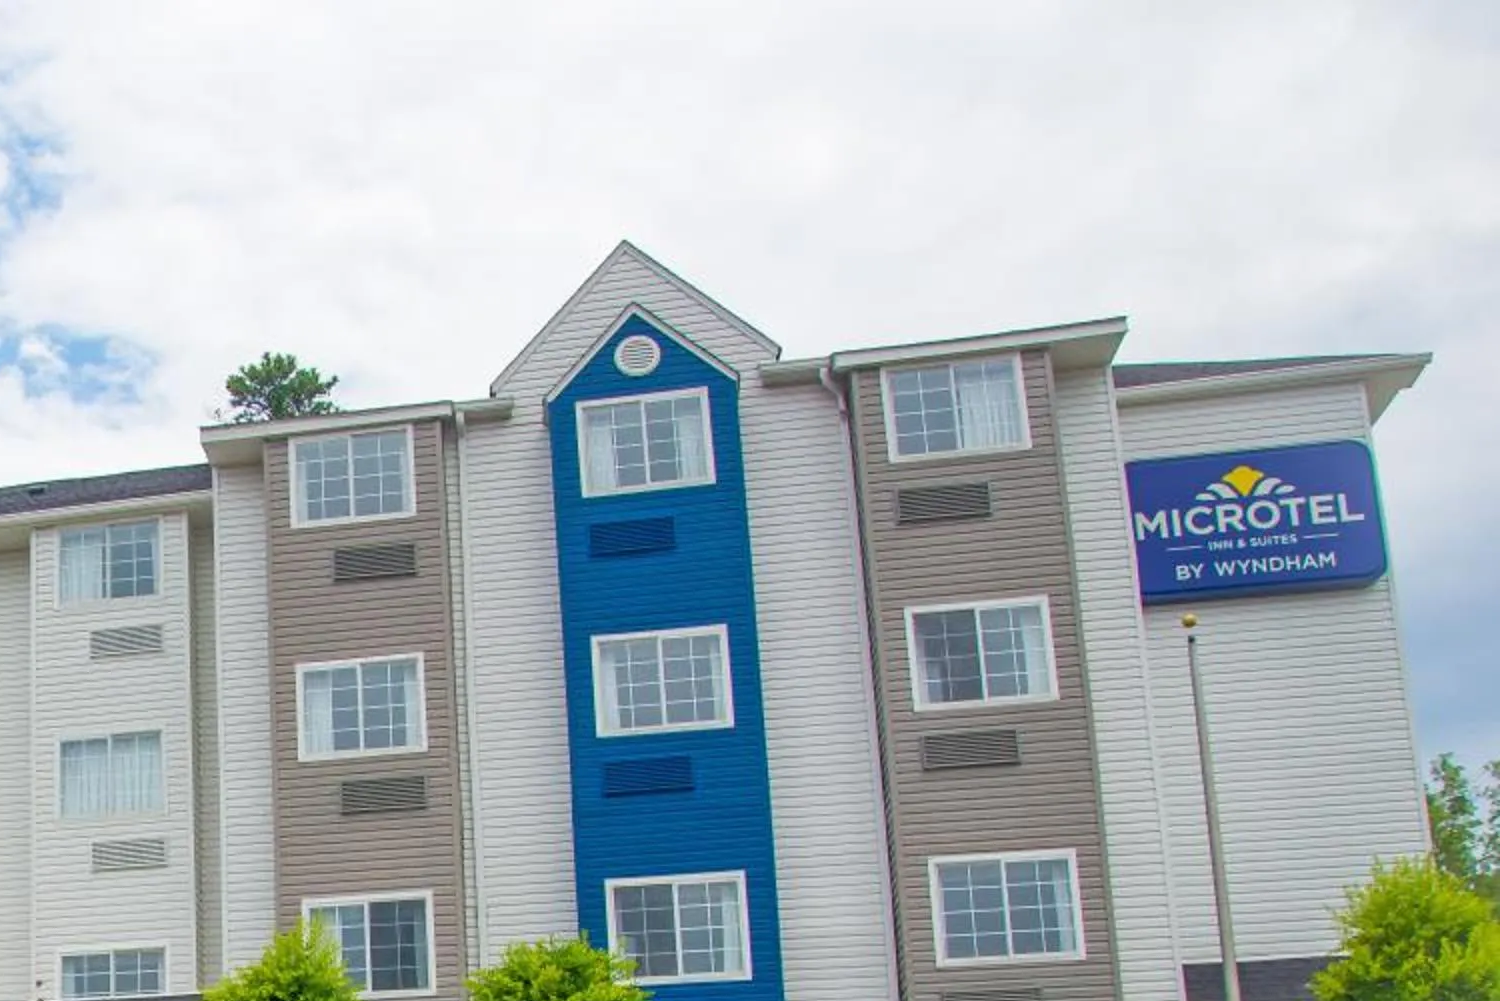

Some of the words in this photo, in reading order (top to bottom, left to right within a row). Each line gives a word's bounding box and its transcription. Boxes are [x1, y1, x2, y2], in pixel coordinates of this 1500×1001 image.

[1134, 493, 1365, 541] MICROTEL
[1207, 538, 1234, 551] INN
[1237, 537, 1247, 549] &
[1249, 533, 1298, 547] SUITES
[1175, 563, 1204, 581] BY
[1214, 551, 1337, 577] WYNDHAM
